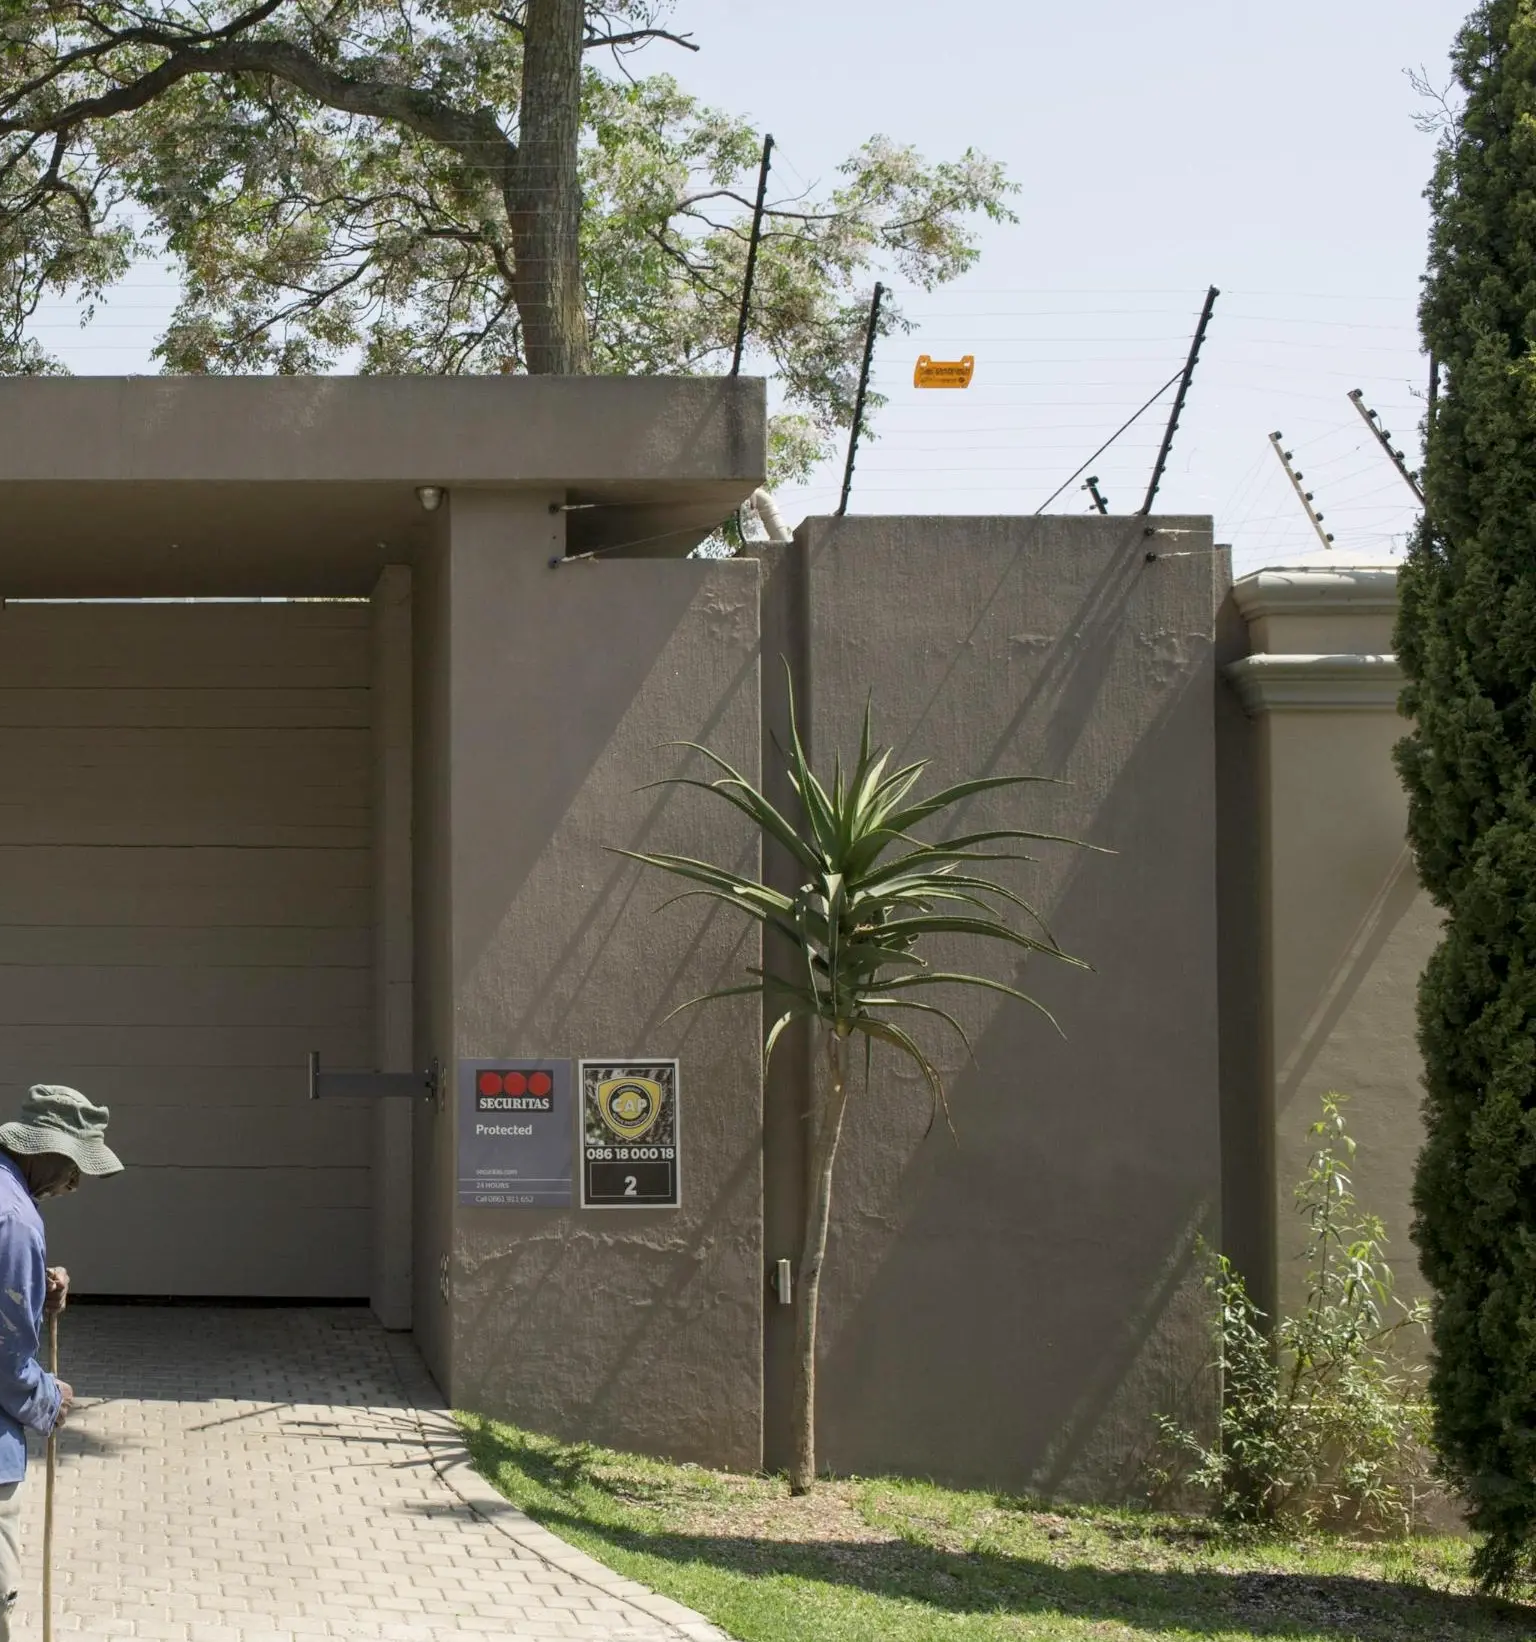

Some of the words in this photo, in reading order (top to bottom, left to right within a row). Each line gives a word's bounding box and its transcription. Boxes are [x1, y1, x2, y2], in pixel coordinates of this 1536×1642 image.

[479, 1098, 550, 1109] SECURITAS
[611, 1098, 648, 1113] CAP
[476, 1123, 533, 1135] Protected
[586, 1148, 612, 1159] 086
[615, 1148, 629, 1159] 18
[630, 1148, 658, 1159] 000
[659, 1148, 675, 1159] 18
[624, 1175, 637, 1196] 2
